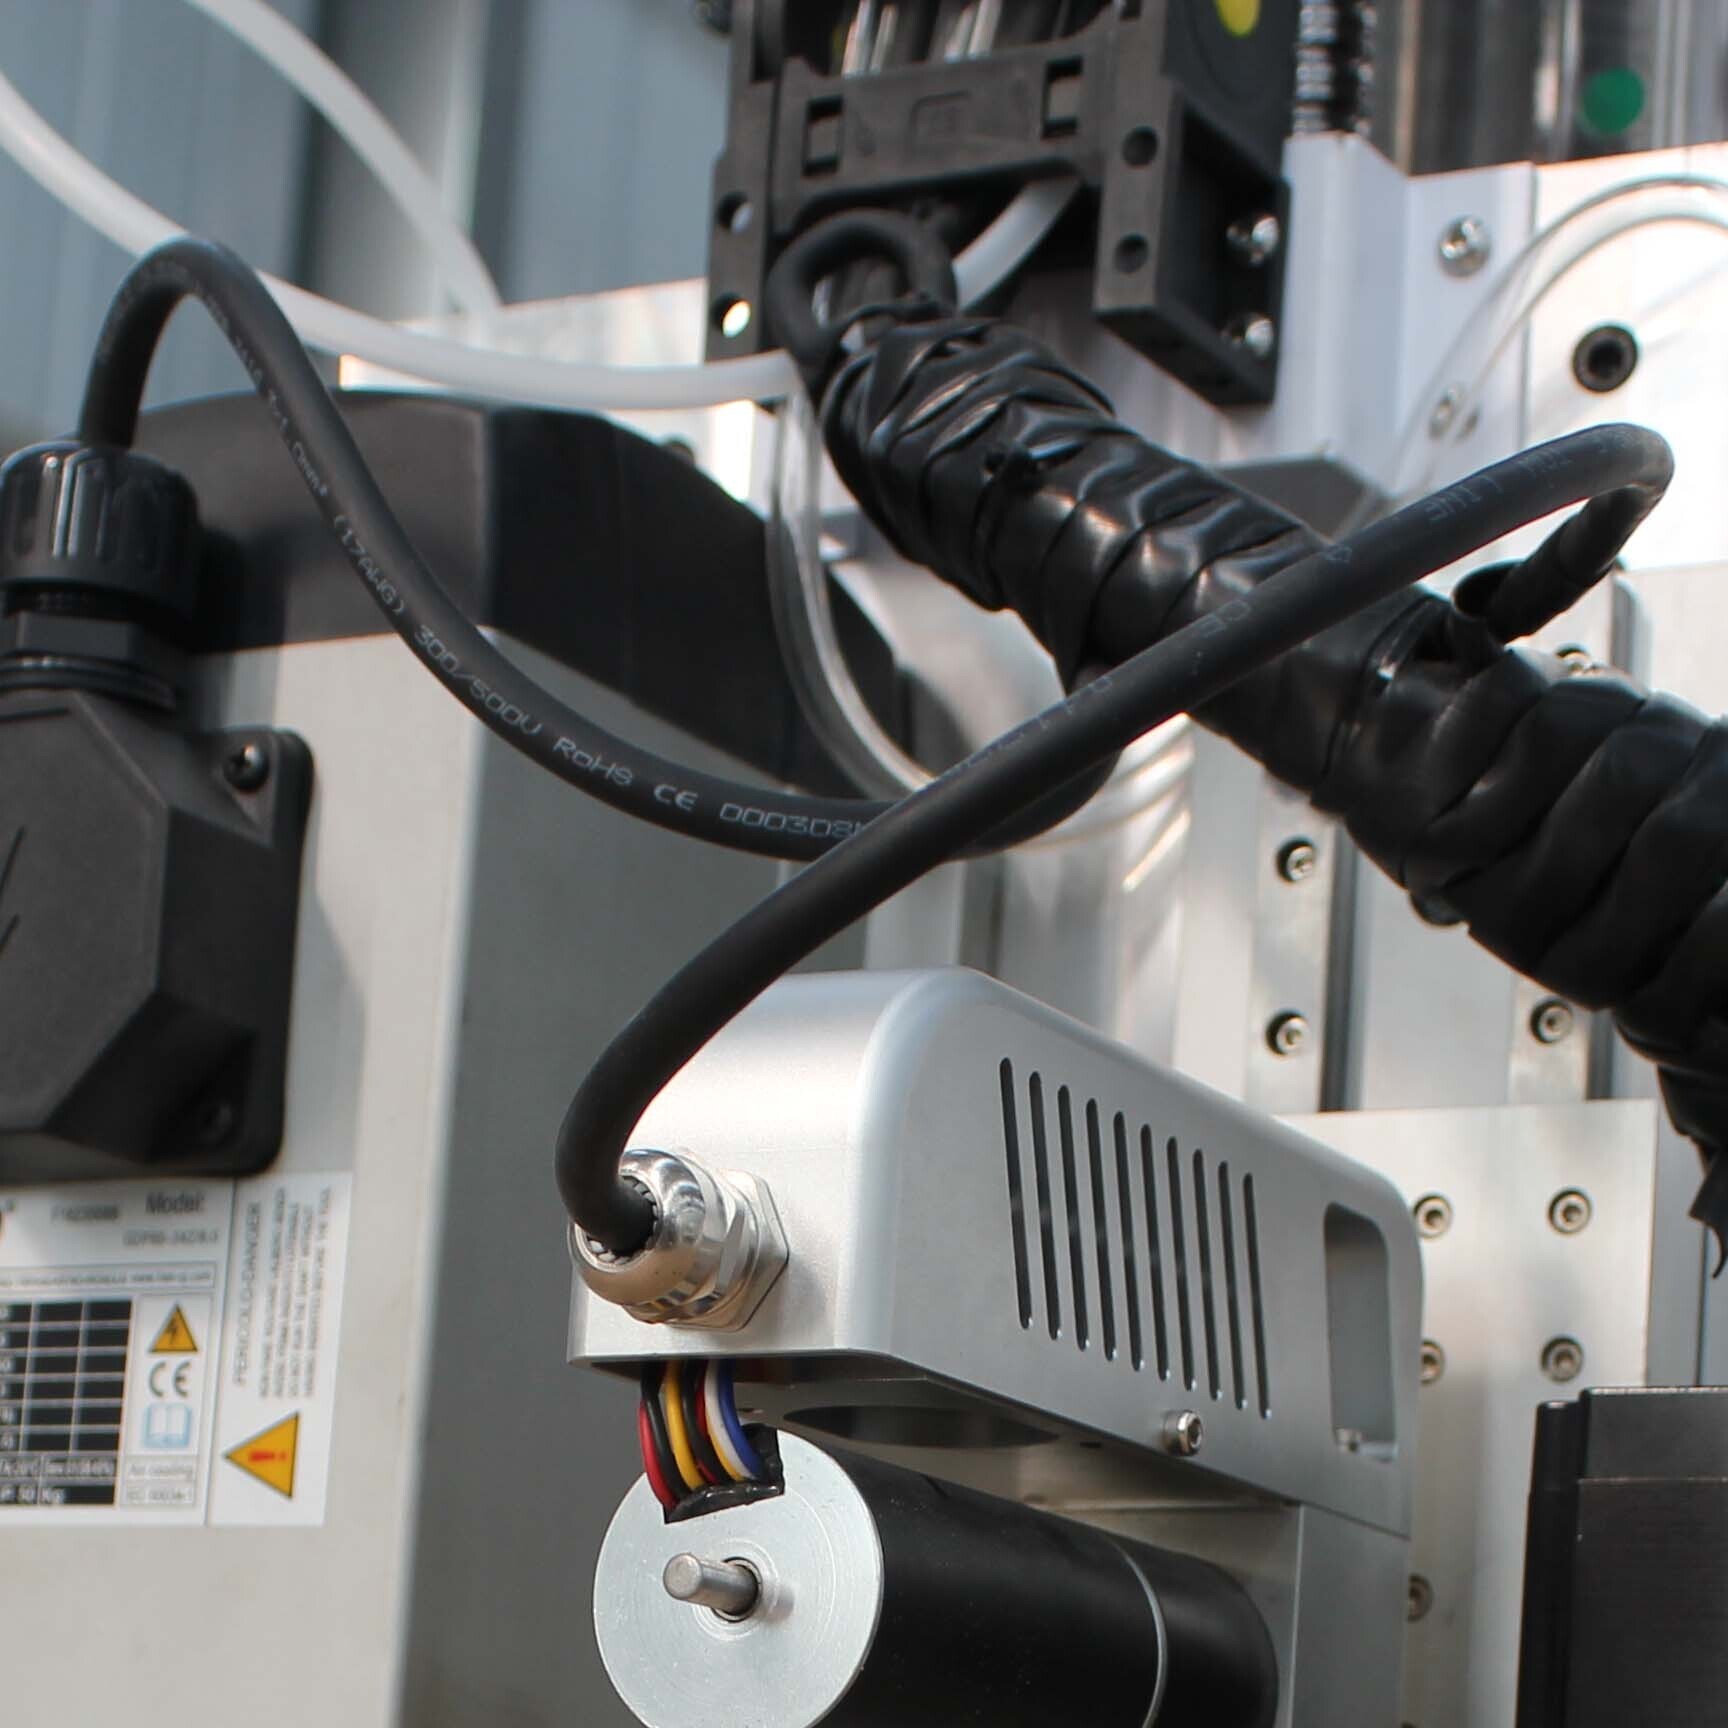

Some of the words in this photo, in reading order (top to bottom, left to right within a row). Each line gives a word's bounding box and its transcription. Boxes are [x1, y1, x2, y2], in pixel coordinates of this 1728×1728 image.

[415, 625, 542, 734] 300/500V
[553, 737, 633, 787] RoHS
[653, 783, 700, 811] CE
